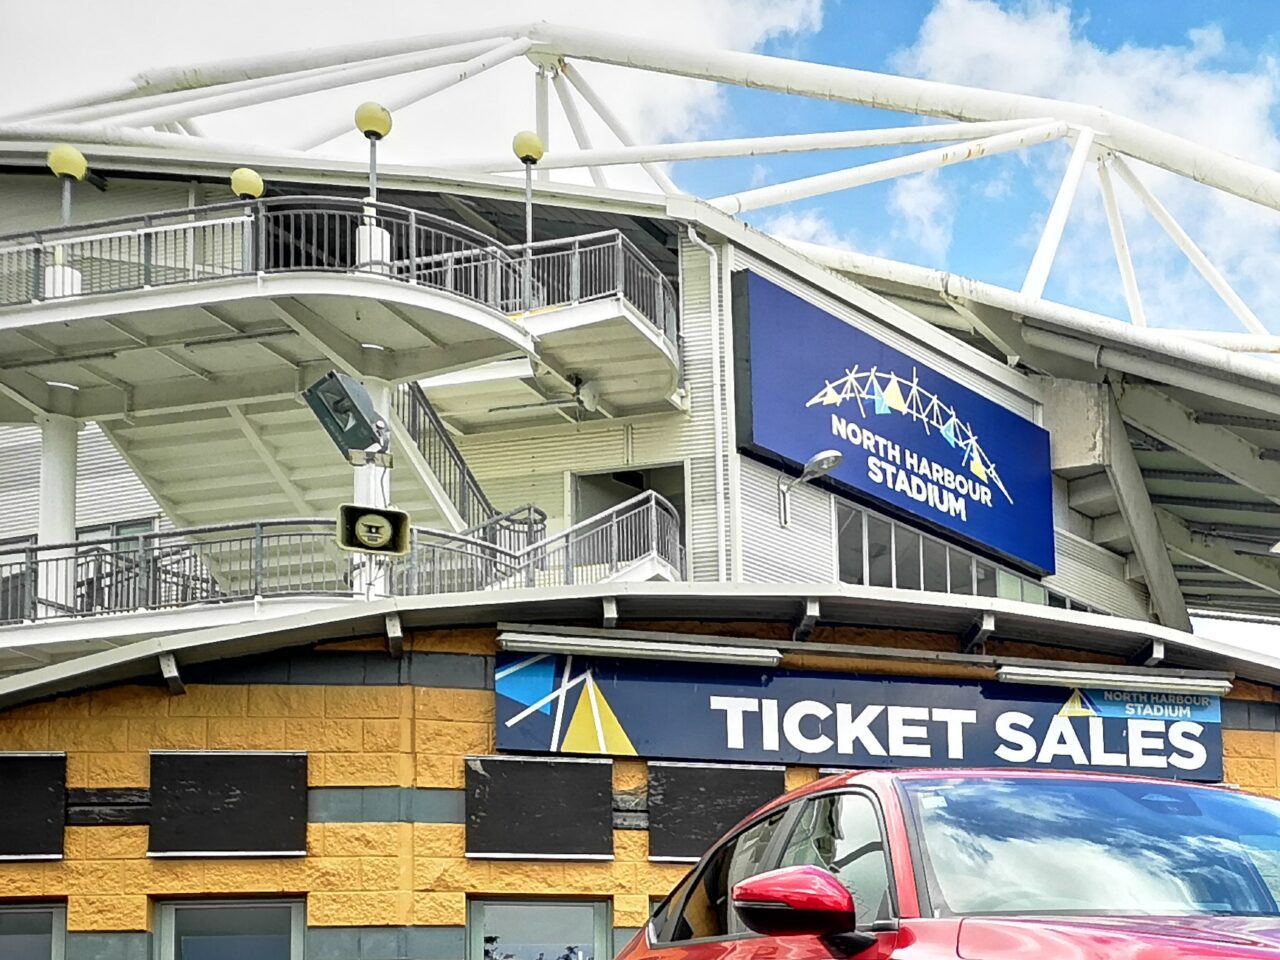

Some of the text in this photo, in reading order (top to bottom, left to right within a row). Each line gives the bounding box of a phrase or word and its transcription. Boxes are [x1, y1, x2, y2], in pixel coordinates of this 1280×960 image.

[832, 414, 993, 507] NORTH HARBOUR
[868, 456, 967, 521] STADIUM
[1104, 691, 1210, 706] NORTH HARBOUR
[1125, 703, 1192, 718] STADIUM
[710, 695, 1208, 771] TICKET SALES
